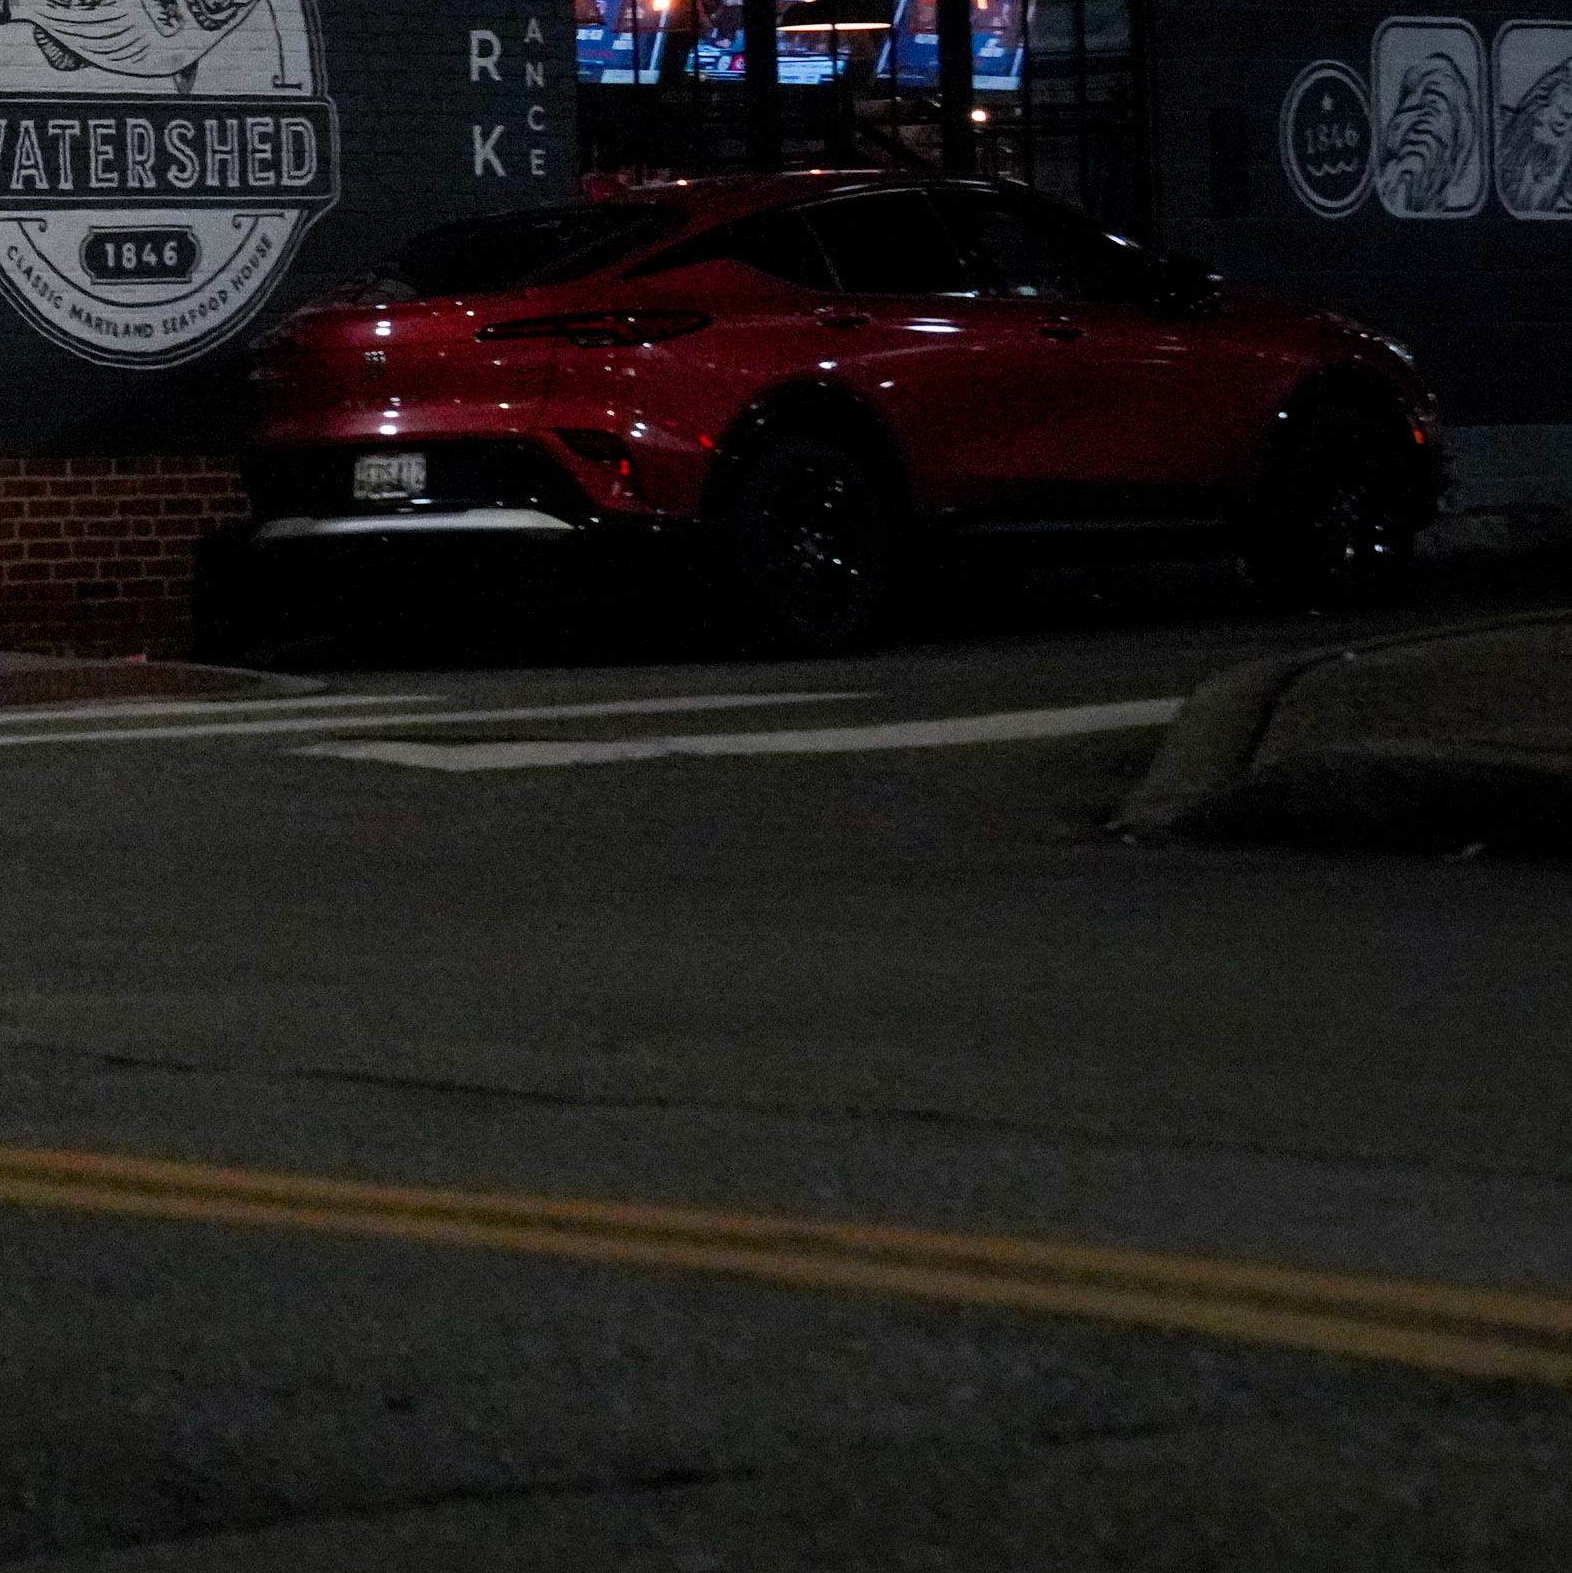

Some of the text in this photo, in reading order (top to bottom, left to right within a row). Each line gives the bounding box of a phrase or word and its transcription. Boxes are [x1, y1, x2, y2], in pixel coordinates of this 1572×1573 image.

[6, 244, 64, 313] CLASSIC
[163, 290, 230, 337] SEAFOOD
[231, 234, 275, 295] HOUSE
[104, 239, 180, 270] 1846
